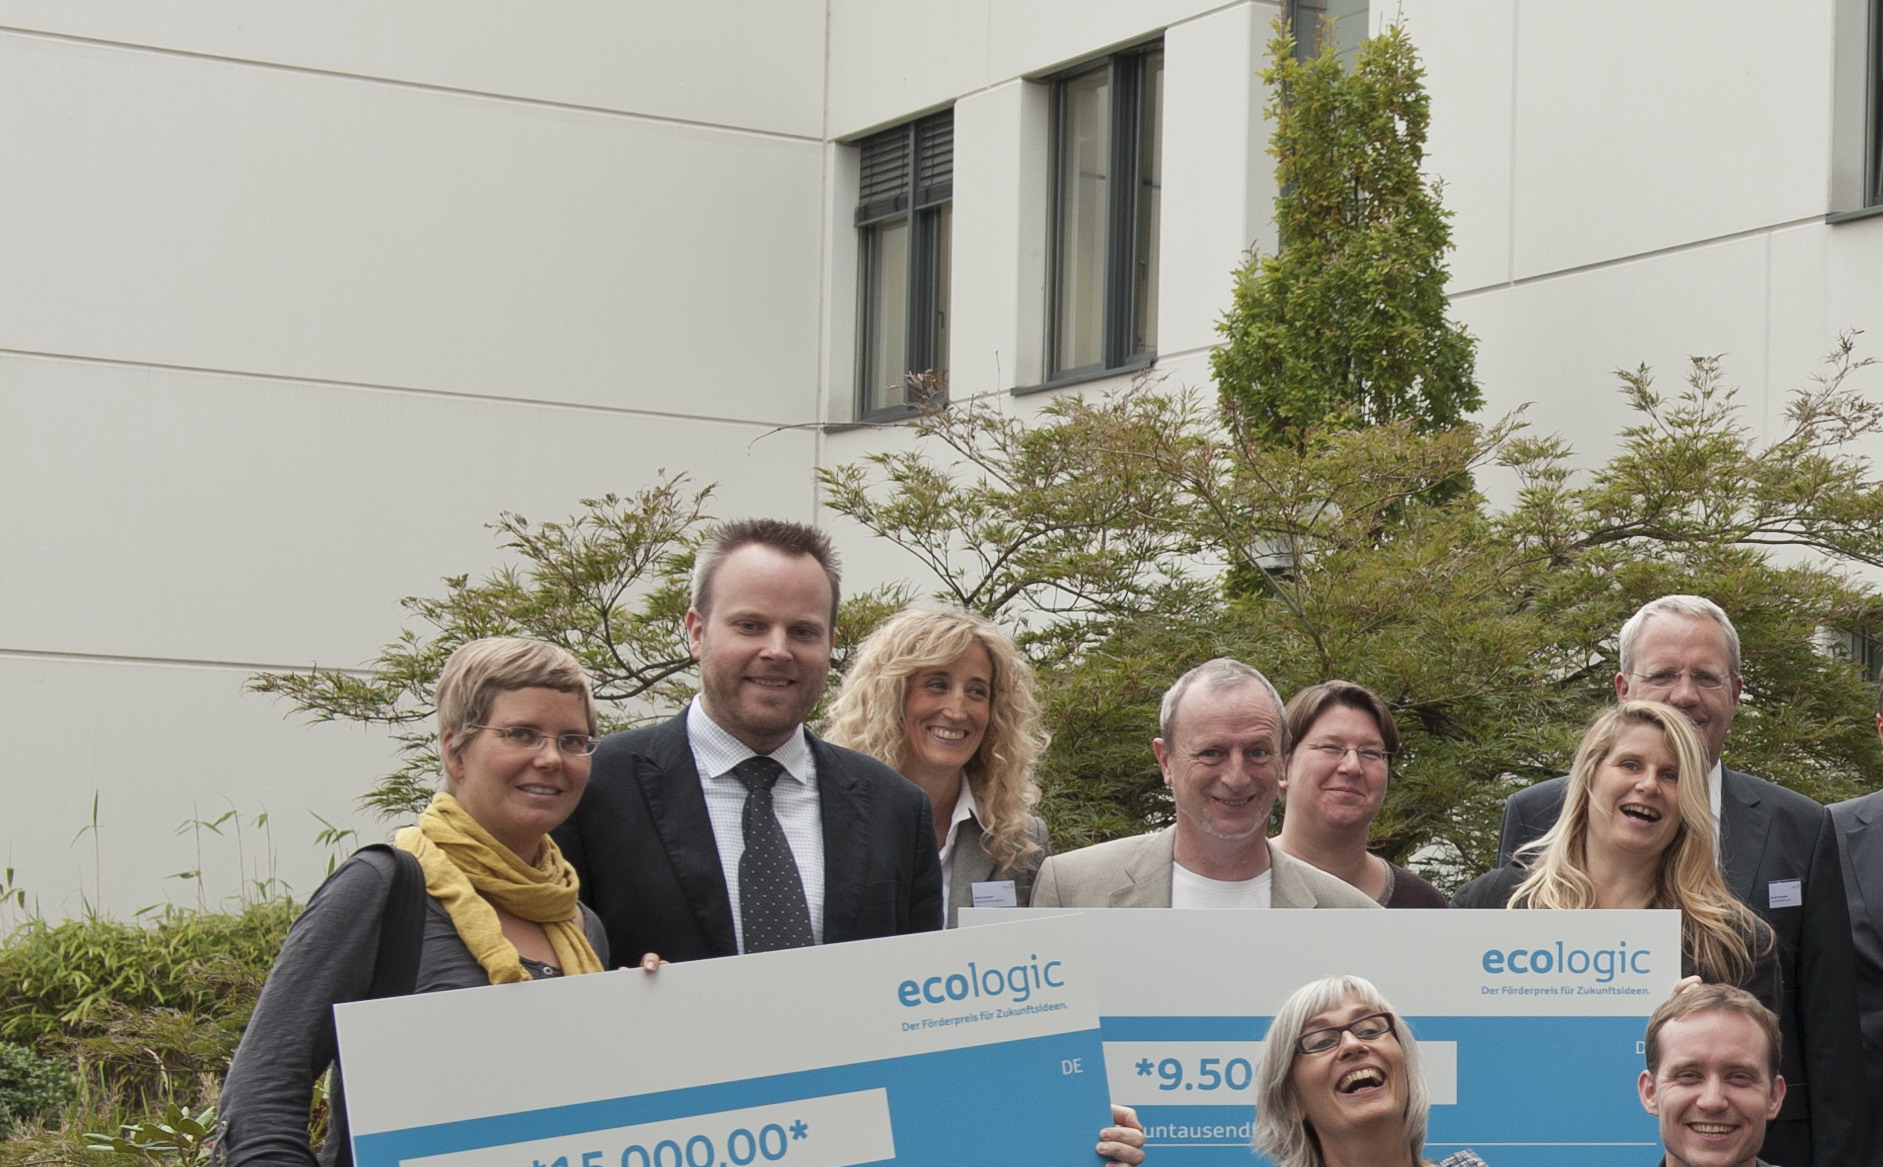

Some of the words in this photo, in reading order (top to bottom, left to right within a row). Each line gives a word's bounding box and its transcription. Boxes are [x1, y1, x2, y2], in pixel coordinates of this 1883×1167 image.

[1481, 940, 1650, 983] ecologic
[897, 952, 1064, 1007] ecologic
[1480, 985, 1500, 995] Der
[1500, 985, 1558, 996] Förderpreis
[1559, 985, 1575, 995] für
[1576, 985, 1650, 995] Zukunftsideen.
[1060, 1057, 1083, 1075] DE
[1135, 1058, 1253, 1091] 9.50
